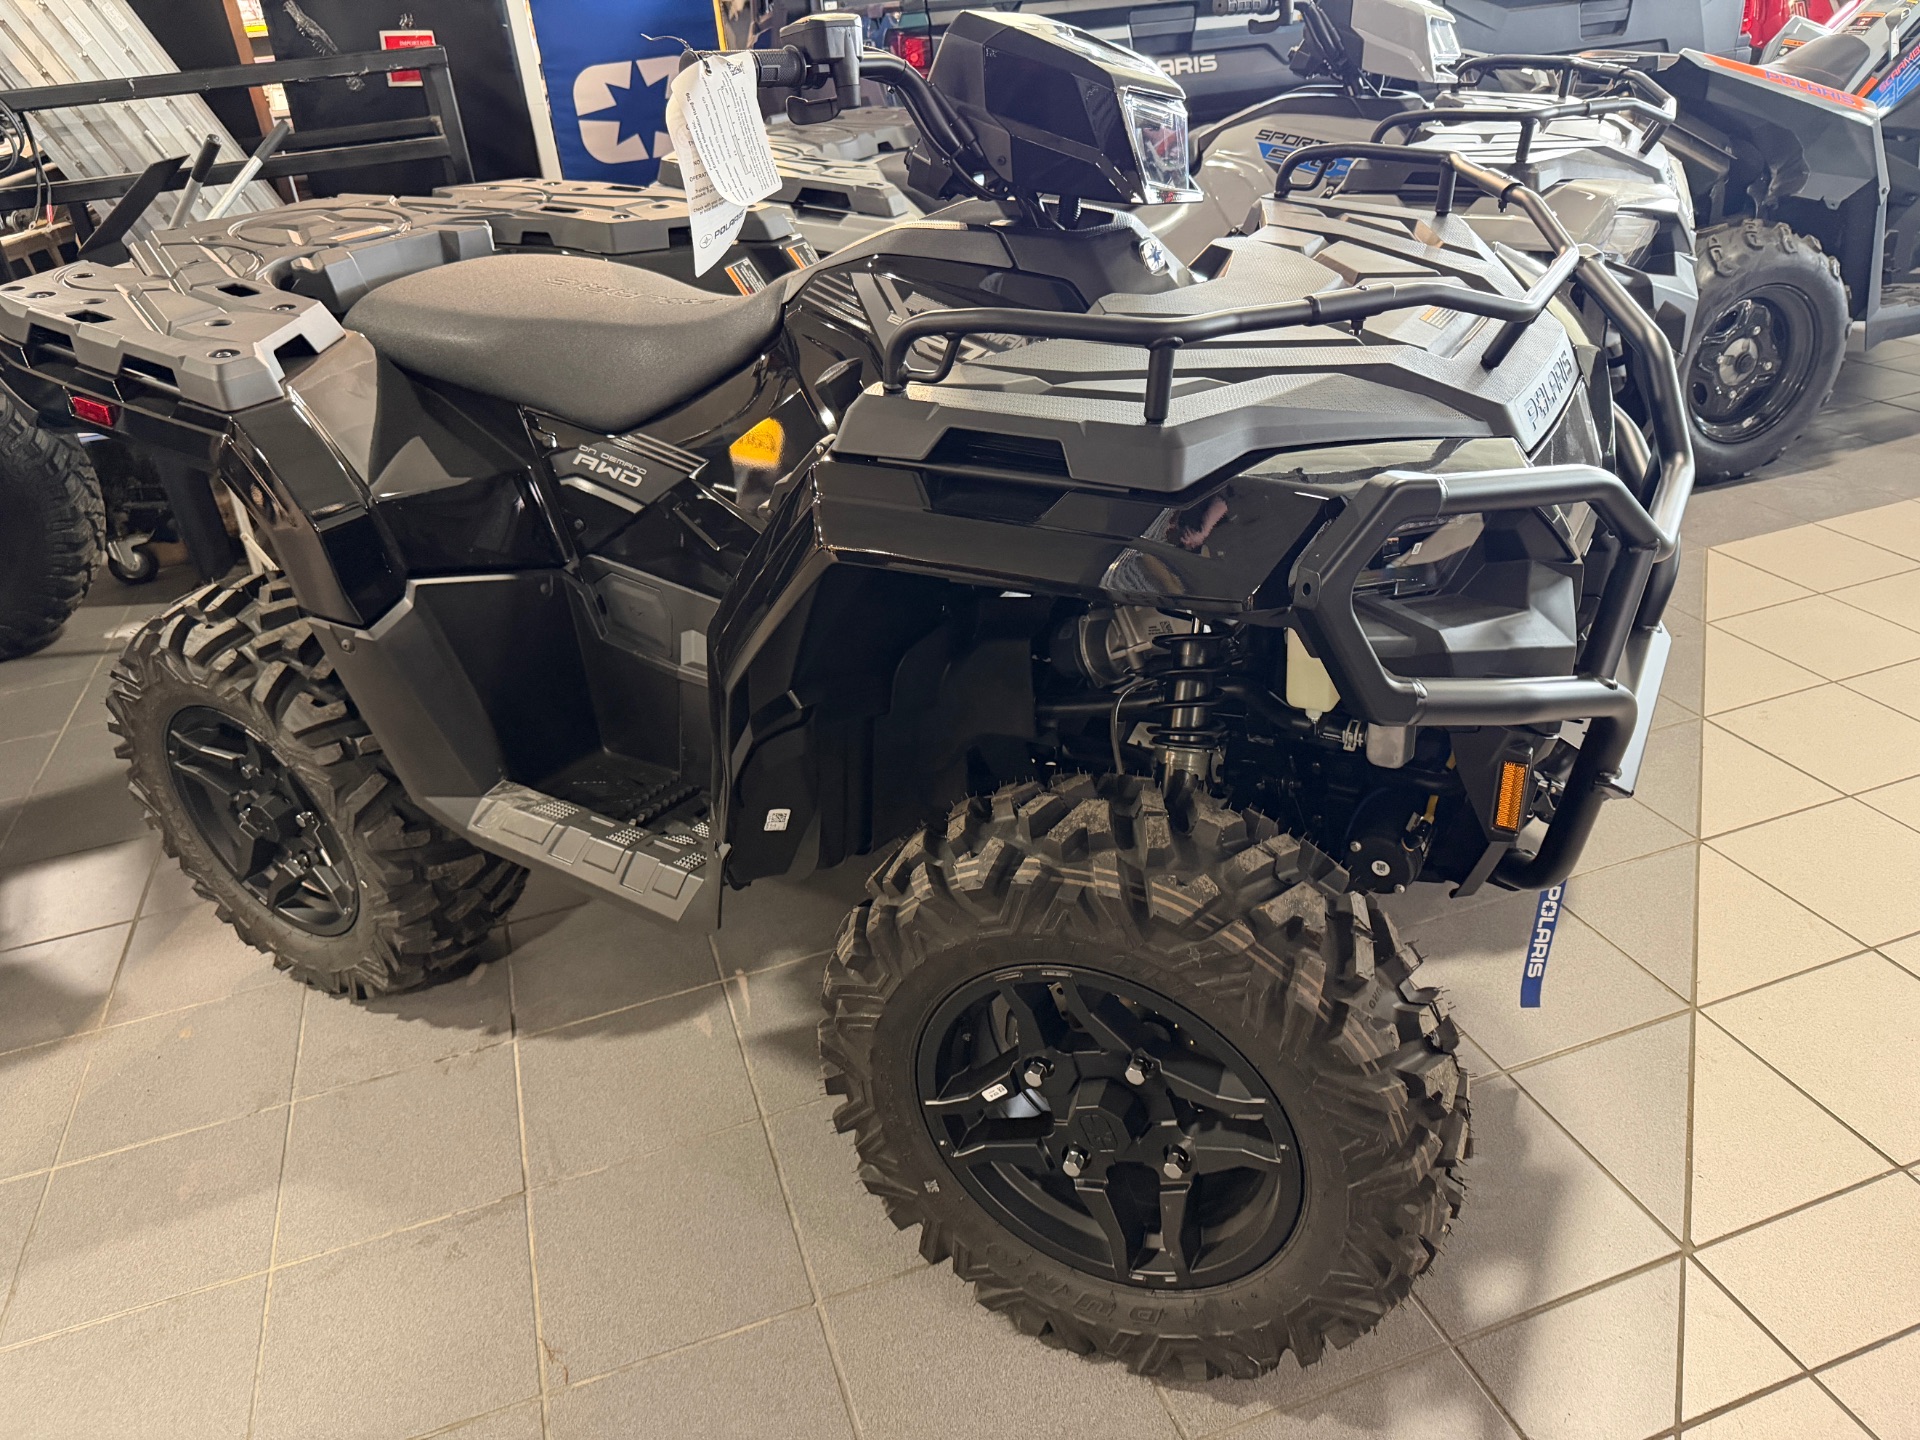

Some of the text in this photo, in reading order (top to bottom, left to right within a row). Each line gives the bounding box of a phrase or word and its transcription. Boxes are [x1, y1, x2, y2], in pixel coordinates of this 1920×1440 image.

[1159, 54, 1218, 76] ARIS
[1878, 42, 1920, 93] SCRAMB
[1764, 69, 1857, 105] POLARIS
[1523, 350, 1573, 431] POLARIS
[572, 453, 643, 488] AWD
[578, 445, 647, 476] ON DEMAND
[1527, 885, 1562, 978] POLARIS
